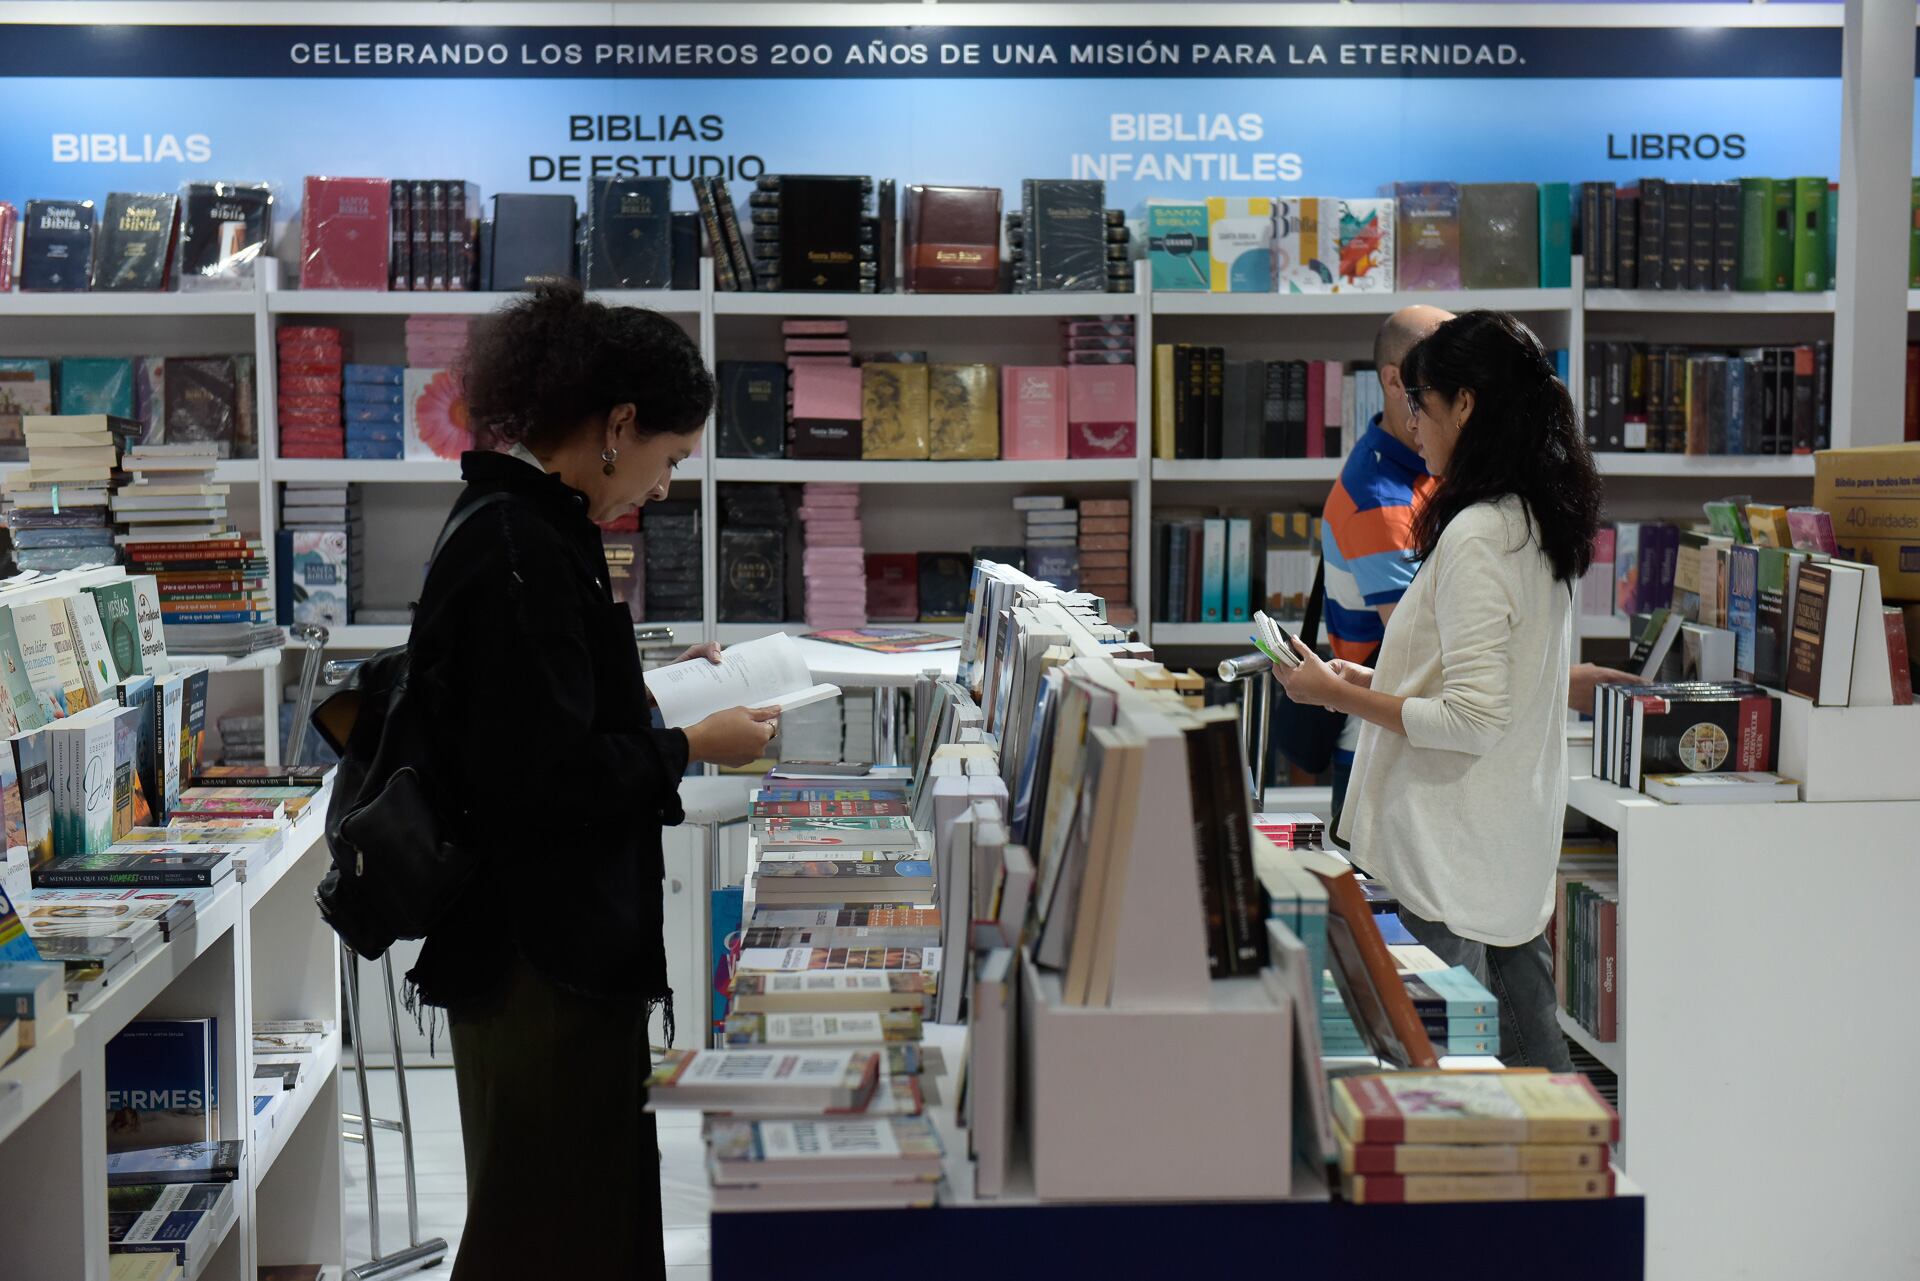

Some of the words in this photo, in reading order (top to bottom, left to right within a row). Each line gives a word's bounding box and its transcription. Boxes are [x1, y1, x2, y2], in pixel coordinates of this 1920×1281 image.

[291, 43, 508, 64] CELEBRANDO
[522, 44, 582, 64] LOS
[596, 45, 757, 64] PRIMEROS
[771, 44, 832, 64] 200
[845, 40, 928, 64] AÑOS
[940, 45, 980, 64] DE
[993, 45, 1057, 64] UNA
[1071, 40, 1178, 64] MISIÓN
[1193, 45, 1276, 64] PARA
[1289, 44, 1328, 64] LA
[1340, 44, 1525, 64] ETERNIDAD.
[570, 115, 723, 141] BIBLIAS
[1110, 113, 1264, 141] BIBLIAS
[52, 134, 212, 163] BIBLIAS
[1607, 134, 1745, 160] LIBROS
[529, 156, 581, 182] DE
[591, 155, 765, 182] ESTUDIO
[1071, 153, 1303, 181] INFANTILES
[40, 217, 81, 230] Biblia
[46, 206, 76, 219] Santa
[126, 206, 157, 219] Santa
[119, 217, 161, 231] Biblia
[1835, 478, 1856, 488] Biblia
[1857, 480, 1874, 488] para
[1876, 478, 1898, 487] todos
[1899, 478, 1910, 486] los
[1846, 506, 1866, 527] 40
[1869, 513, 1919, 528] unidades
[108, 598, 130, 618] MESÍAS
[143, 627, 151, 640] del
[141, 641, 164, 657] Evangelio
[1749, 711, 1758, 754] DICCIONARIO
[1755, 733, 1764, 759] NUEVO
[109, 873, 139, 882] HOMBRES
[1604, 956, 1614, 993] Santiago
[106, 1089, 202, 1109] FIRMES
